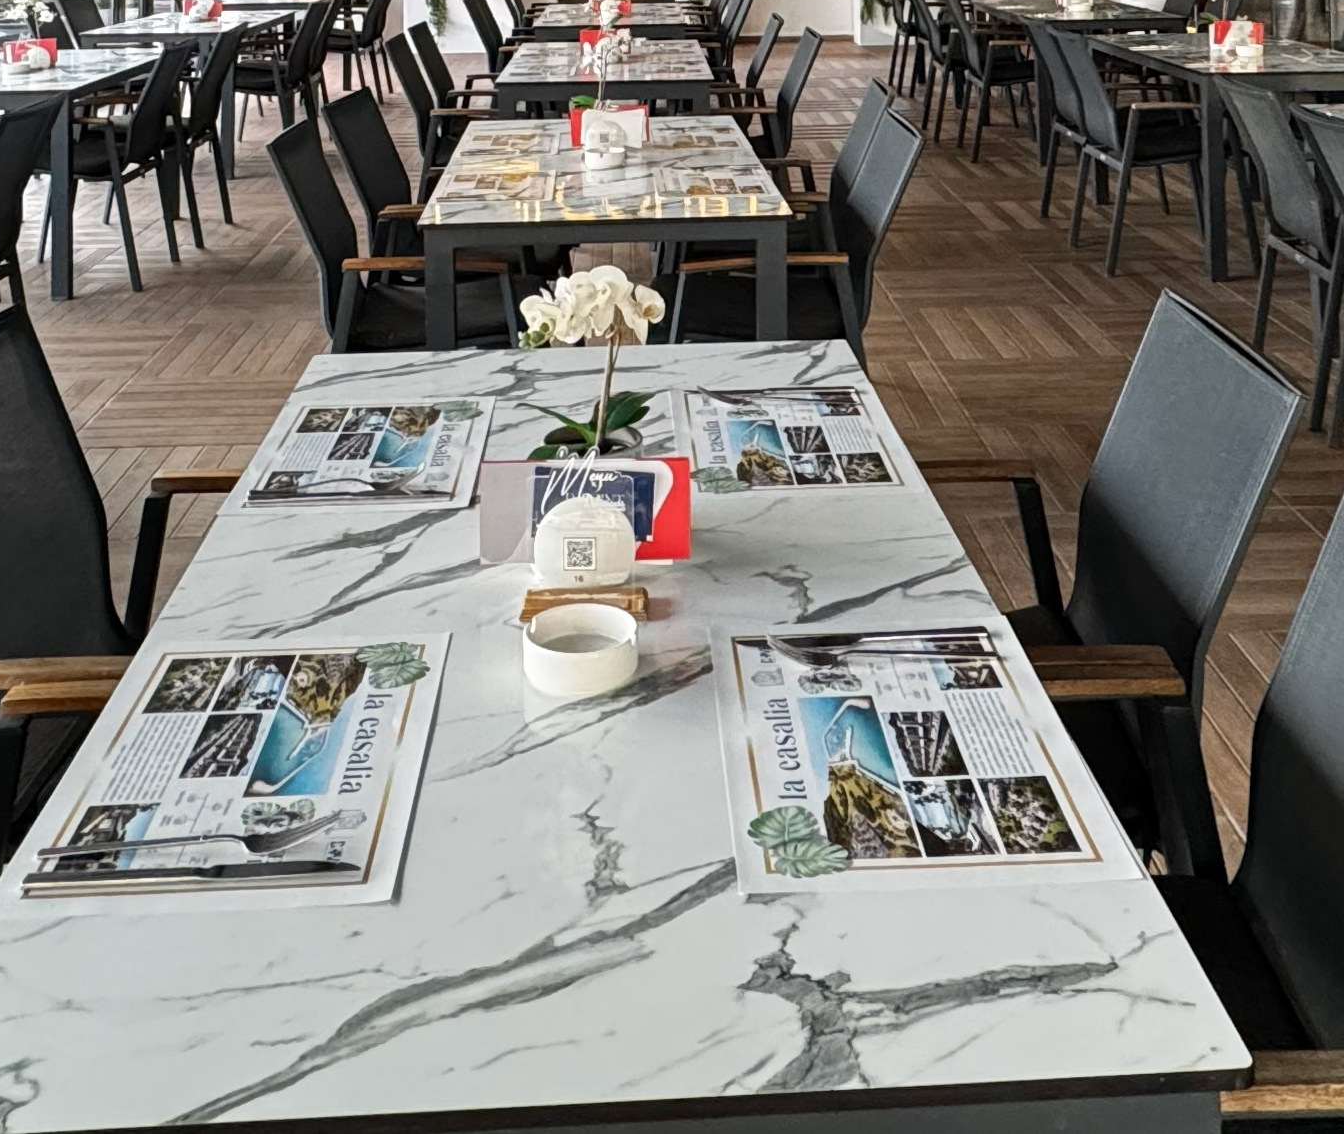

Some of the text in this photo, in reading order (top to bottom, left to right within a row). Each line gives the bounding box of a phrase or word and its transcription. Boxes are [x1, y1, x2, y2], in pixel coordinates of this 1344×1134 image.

[338, 694, 393, 795] la casalia
[763, 697, 801, 771] casalia
[778, 779, 807, 800] la
